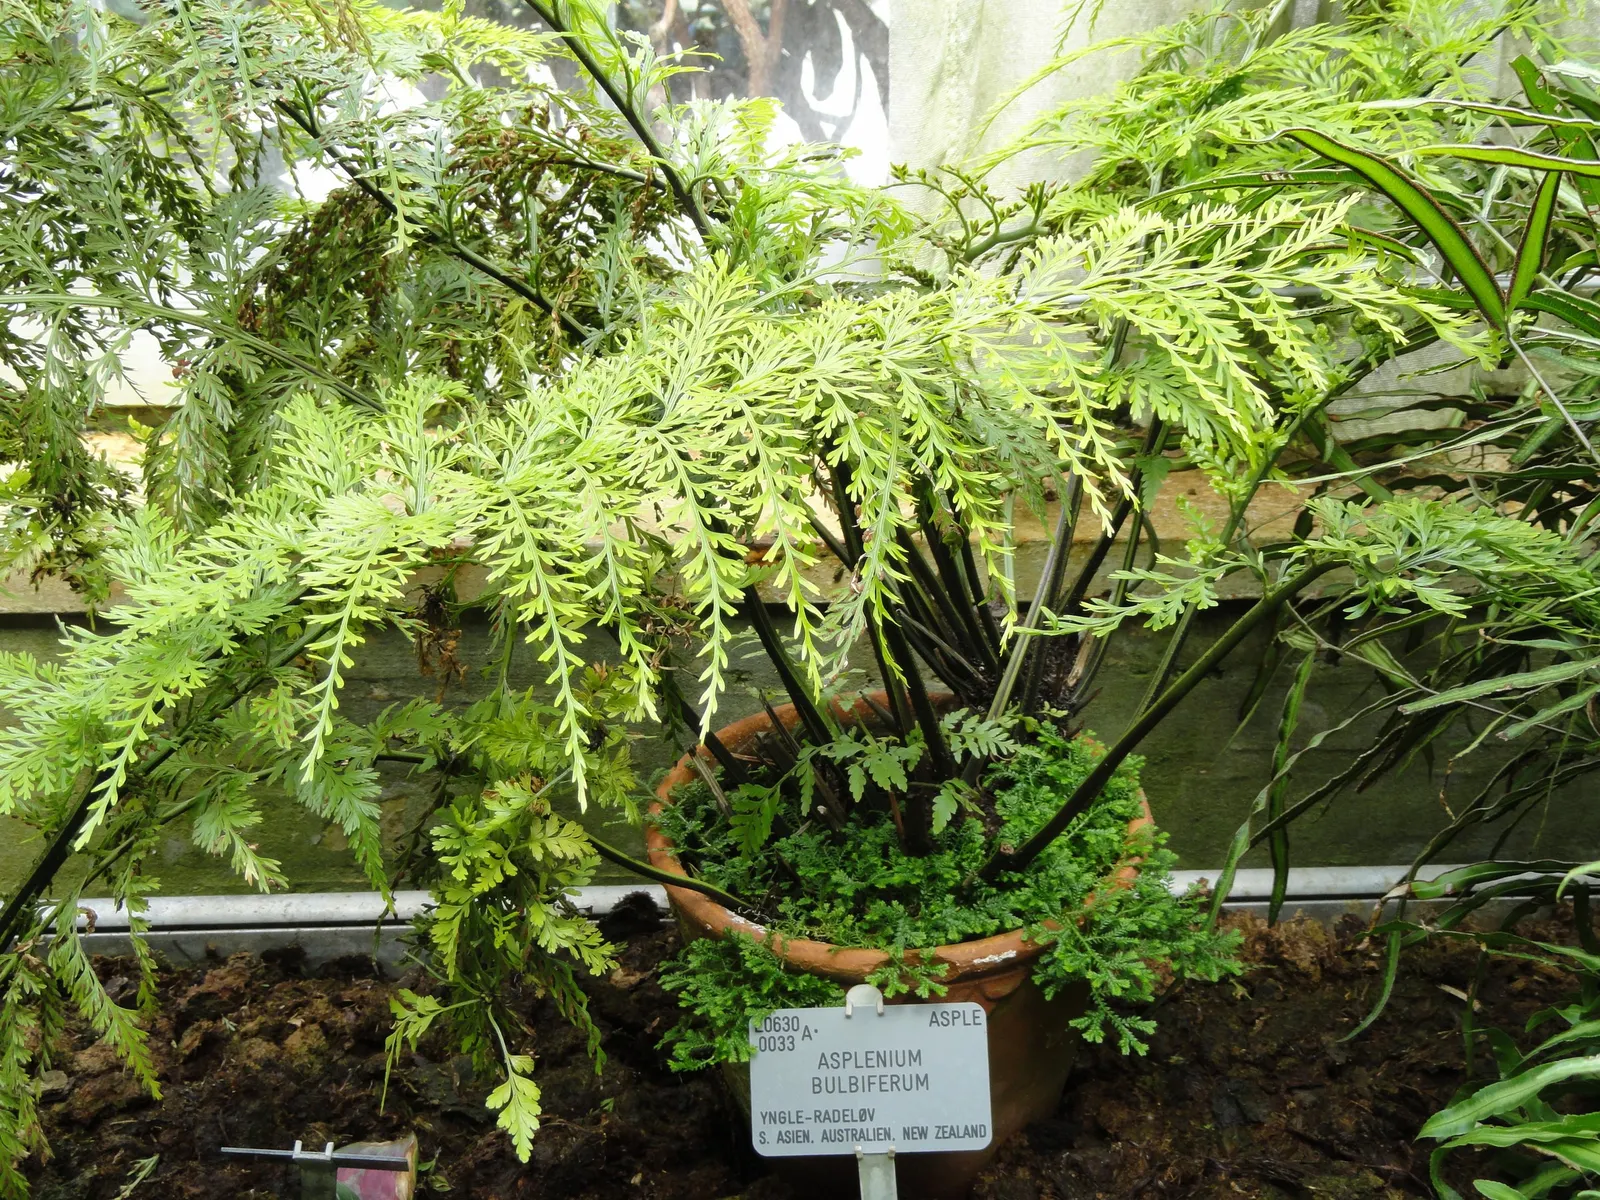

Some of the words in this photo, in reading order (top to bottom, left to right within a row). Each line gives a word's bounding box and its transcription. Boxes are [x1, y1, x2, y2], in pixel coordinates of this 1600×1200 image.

[755, 1015, 800, 1032] 0630
[929, 1009, 982, 1027] ASPLE
[759, 1035, 795, 1052] 0033
[818, 1049, 922, 1069] ASPLENIUM
[812, 1073, 930, 1094] BULBIFERUM
[760, 1108, 876, 1125] YNGLE-RADELØV
[759, 1130, 770, 1144] S.
[902, 1125, 929, 1140] NEW
[934, 1124, 987, 1139] ZEALAND
